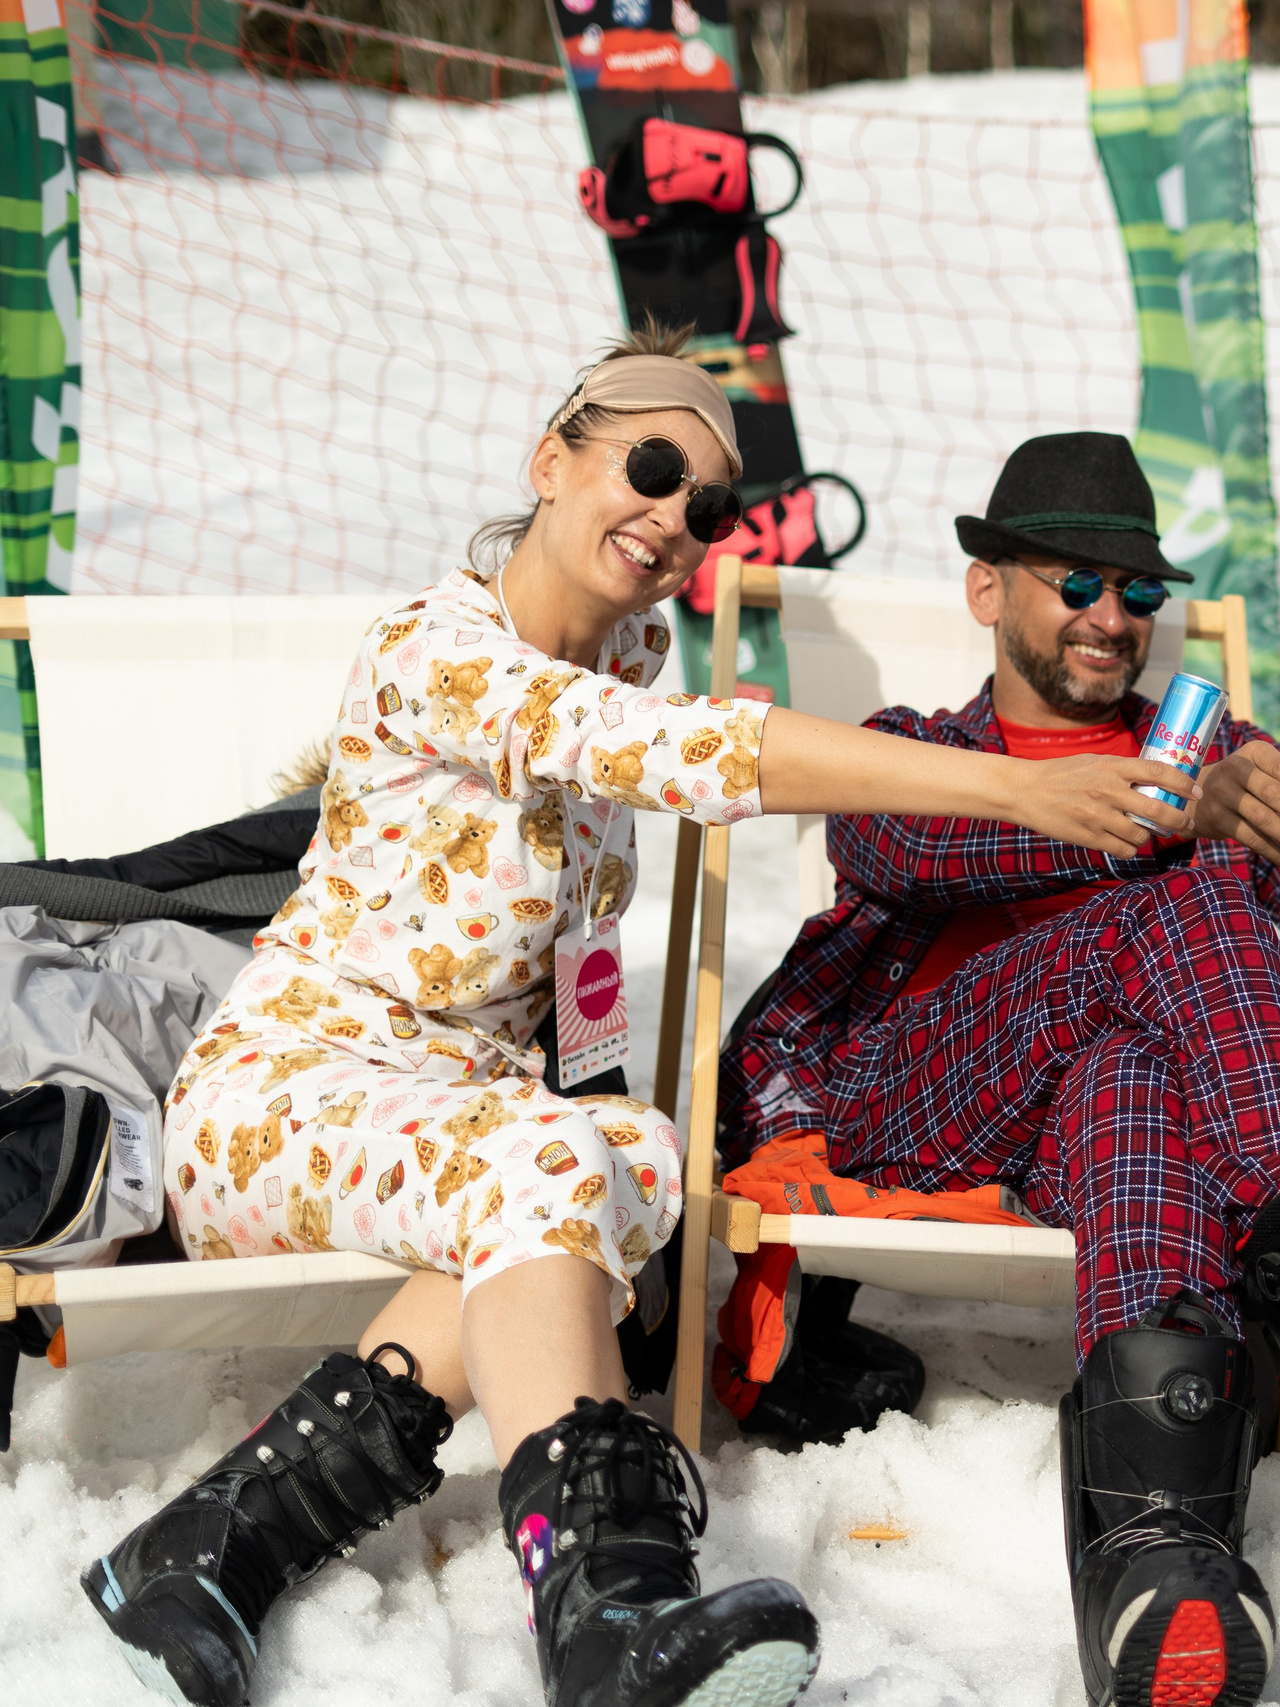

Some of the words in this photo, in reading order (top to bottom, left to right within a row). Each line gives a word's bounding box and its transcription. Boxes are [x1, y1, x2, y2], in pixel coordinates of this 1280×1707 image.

[385, 685, 398, 712] HONEY
[1155, 723, 1188, 747] Red
[540, 1145, 569, 1170] HONEY
